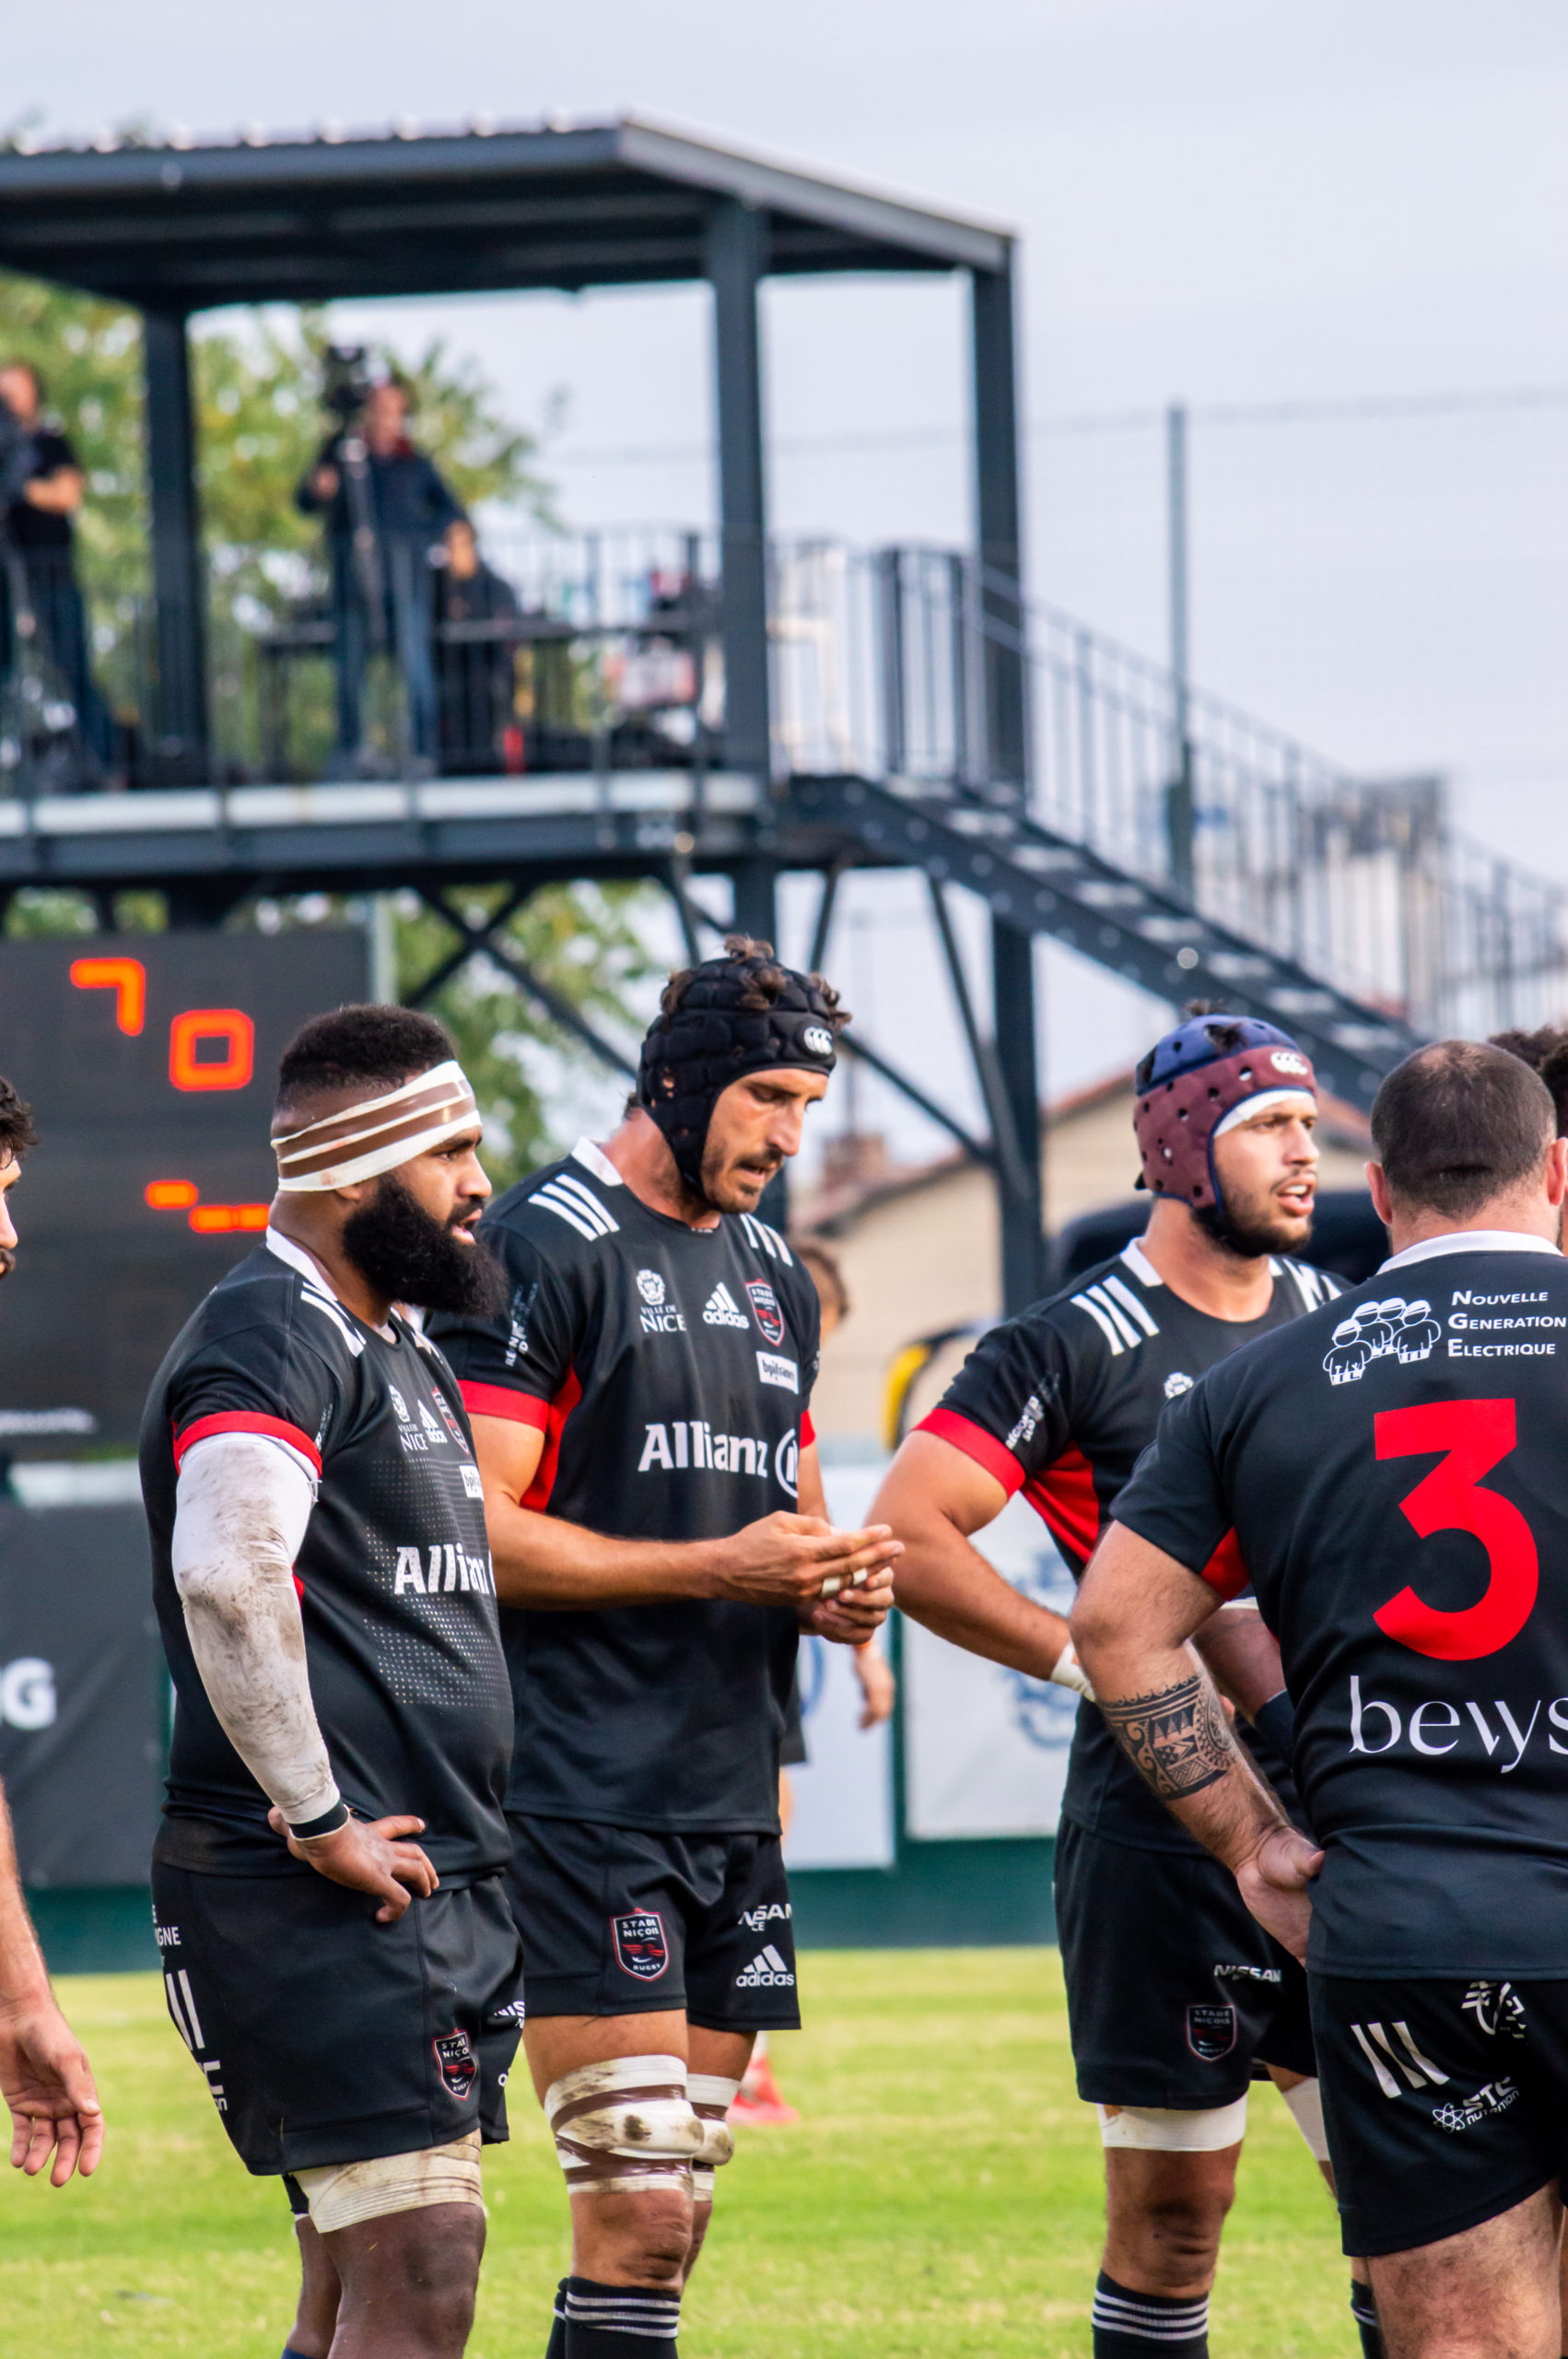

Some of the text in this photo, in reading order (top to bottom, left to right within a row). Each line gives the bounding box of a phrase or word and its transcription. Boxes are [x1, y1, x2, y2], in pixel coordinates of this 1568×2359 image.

[639, 1314, 687, 1332] NICE
[702, 1309, 750, 1329] adidas
[1448, 1312, 1567, 1330] GENERATION
[1447, 1338, 1556, 1357] ELECTRIQUE
[638, 1420, 768, 1479] Allianz
[1373, 1398, 1539, 1661] 3
[736, 1970, 795, 1987] adidas
